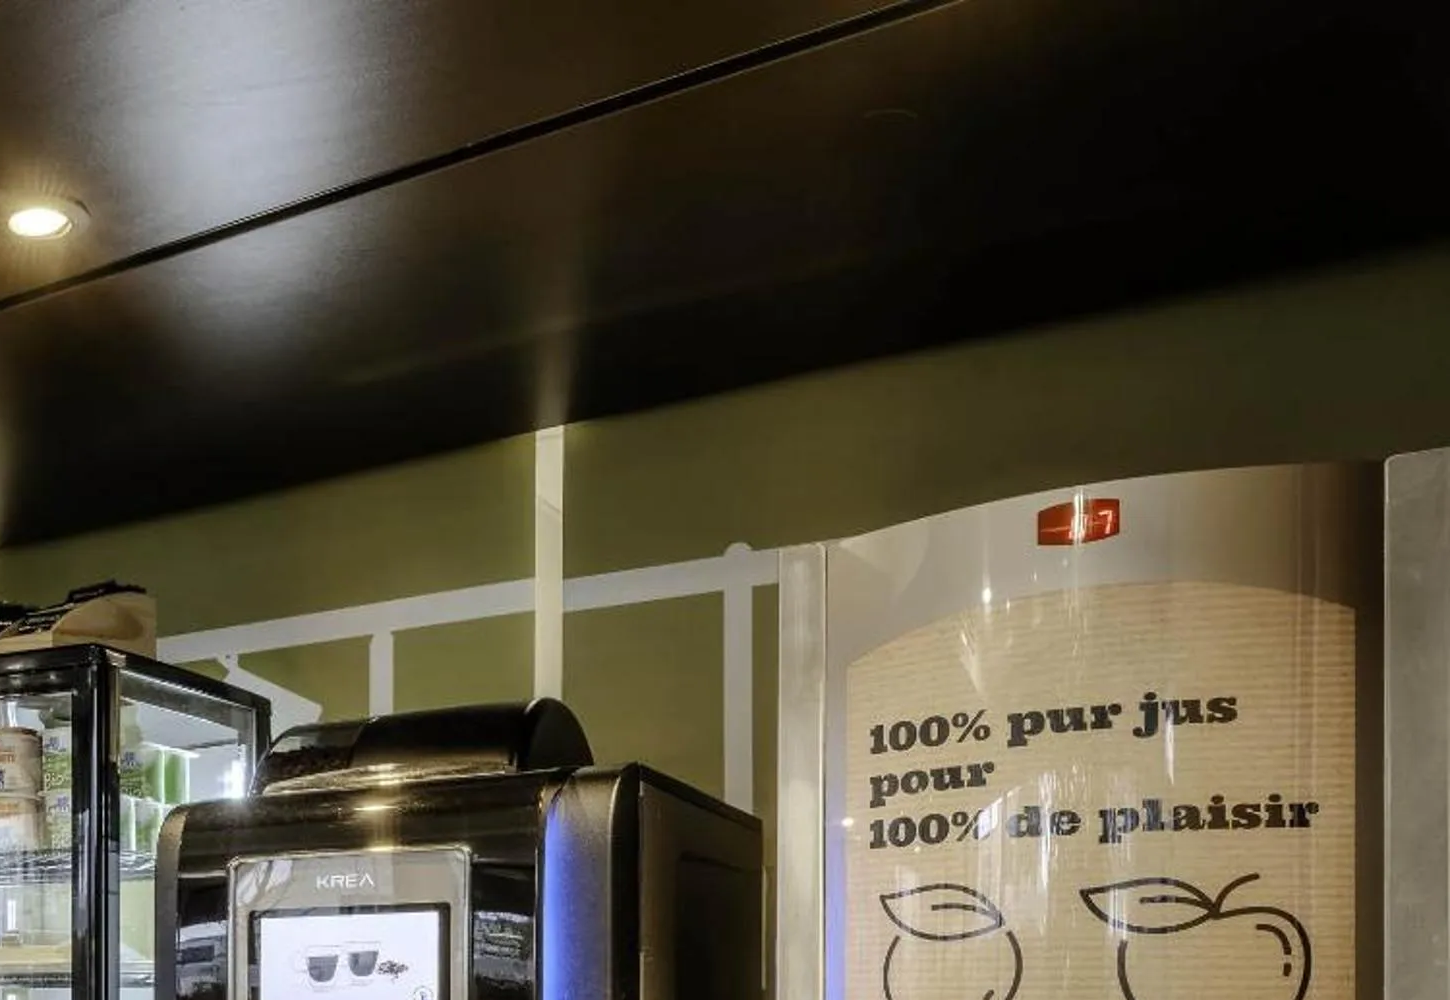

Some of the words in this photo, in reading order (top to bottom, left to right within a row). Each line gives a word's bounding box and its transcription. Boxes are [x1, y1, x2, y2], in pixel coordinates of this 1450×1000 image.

[869, 708, 991, 754] 100%
[1007, 701, 1122, 748] pur
[1132, 691, 1239, 738] jus
[869, 761, 996, 808] pour
[869, 808, 991, 850] 100%
[1008, 805, 1081, 839] de
[1099, 793, 1320, 844] plaisir
[316, 873, 375, 889] KREA
